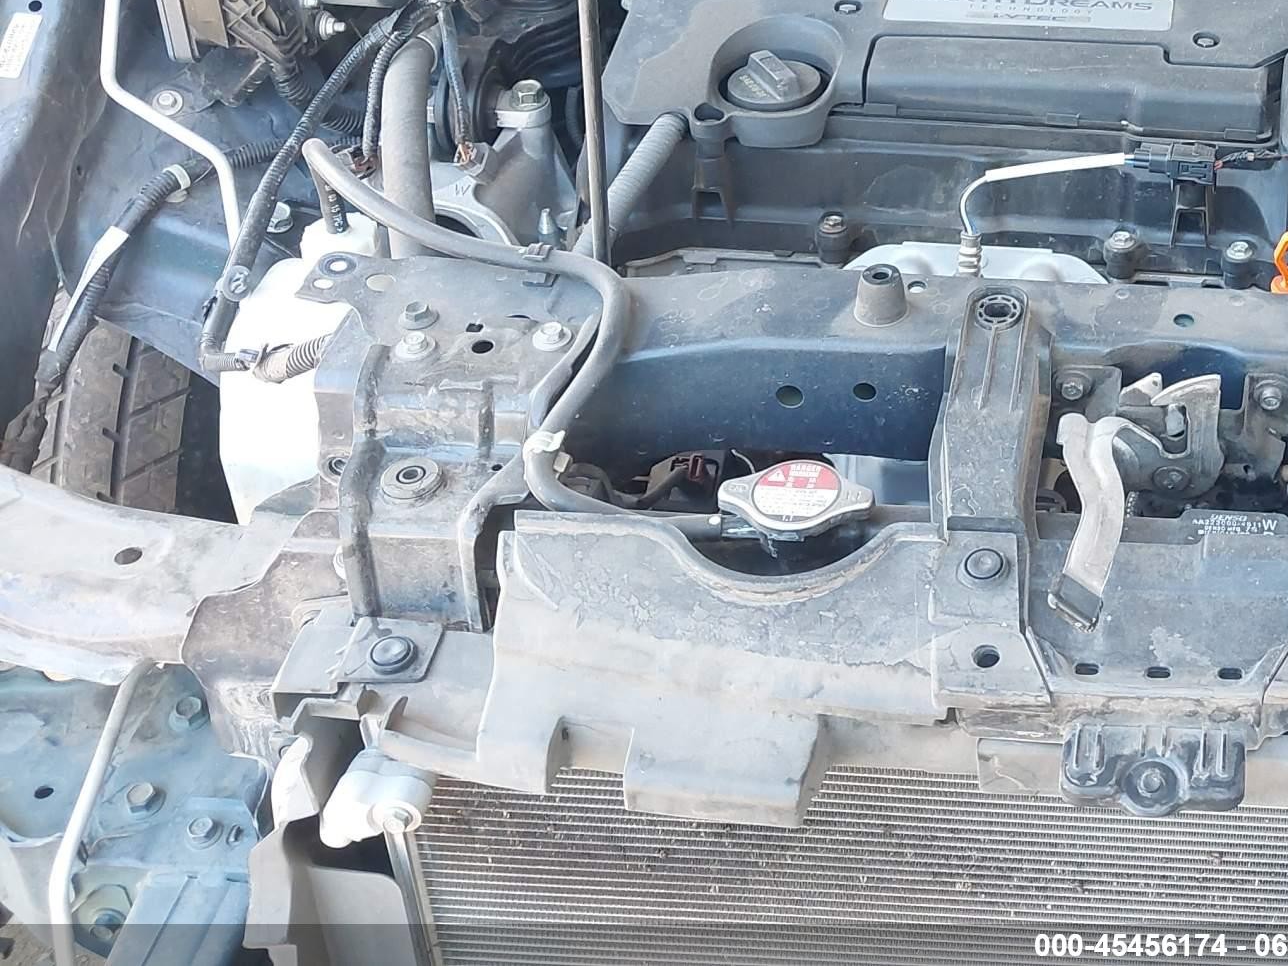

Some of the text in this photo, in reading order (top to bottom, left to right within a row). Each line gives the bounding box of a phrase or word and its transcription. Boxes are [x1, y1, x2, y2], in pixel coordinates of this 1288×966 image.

[968, 3, 1094, 15] TECHNOLOGY
[1210, 514, 1248, 522] DENSO
[1262, 518, 1278, 531] W
